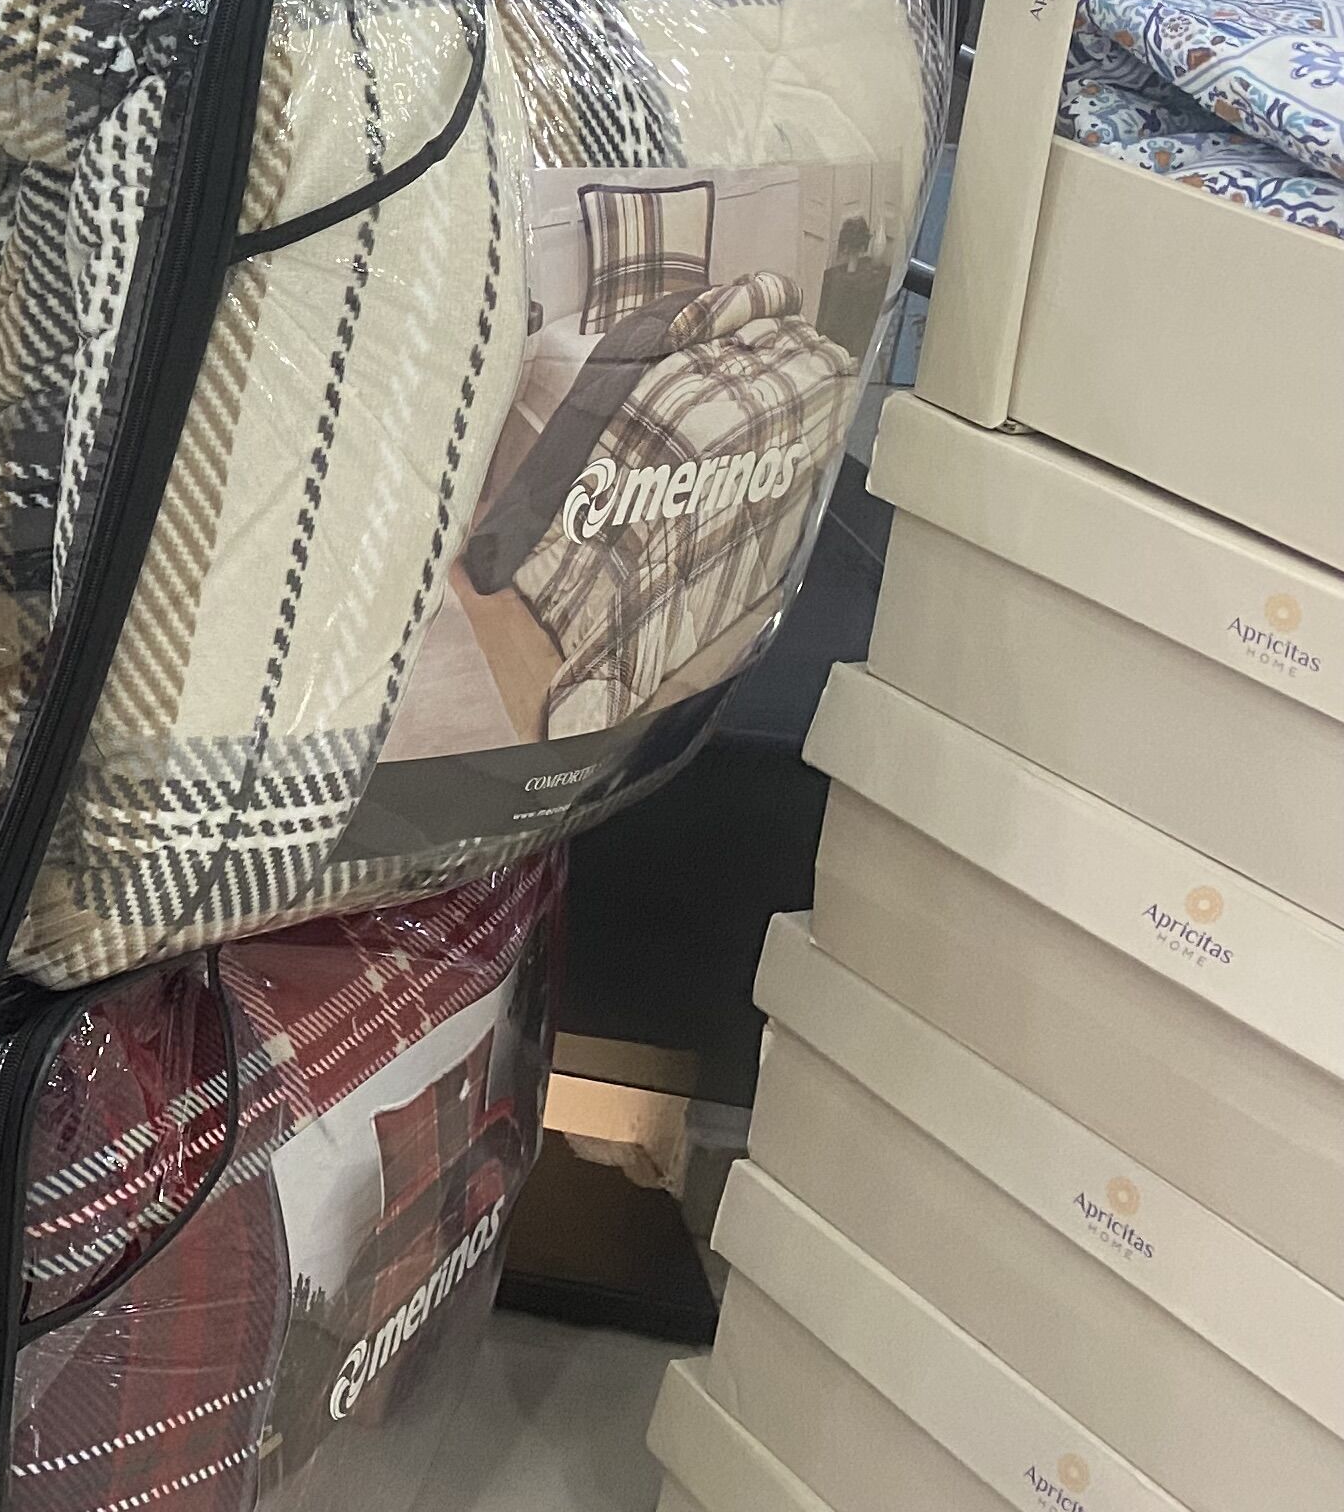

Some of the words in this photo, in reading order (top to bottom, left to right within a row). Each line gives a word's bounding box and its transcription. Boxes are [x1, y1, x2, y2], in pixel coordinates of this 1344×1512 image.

[612, 440, 810, 527] merinos
[1226, 616, 1322, 673] Apricitas
[1245, 647, 1298, 678] HOME
[1141, 903, 1234, 964] Apricitas
[1156, 932, 1208, 968] HOME
[1073, 1192, 1155, 1259] Apricitas
[1087, 1224, 1136, 1261] HOME
[367, 1193, 505, 1382] merinos
